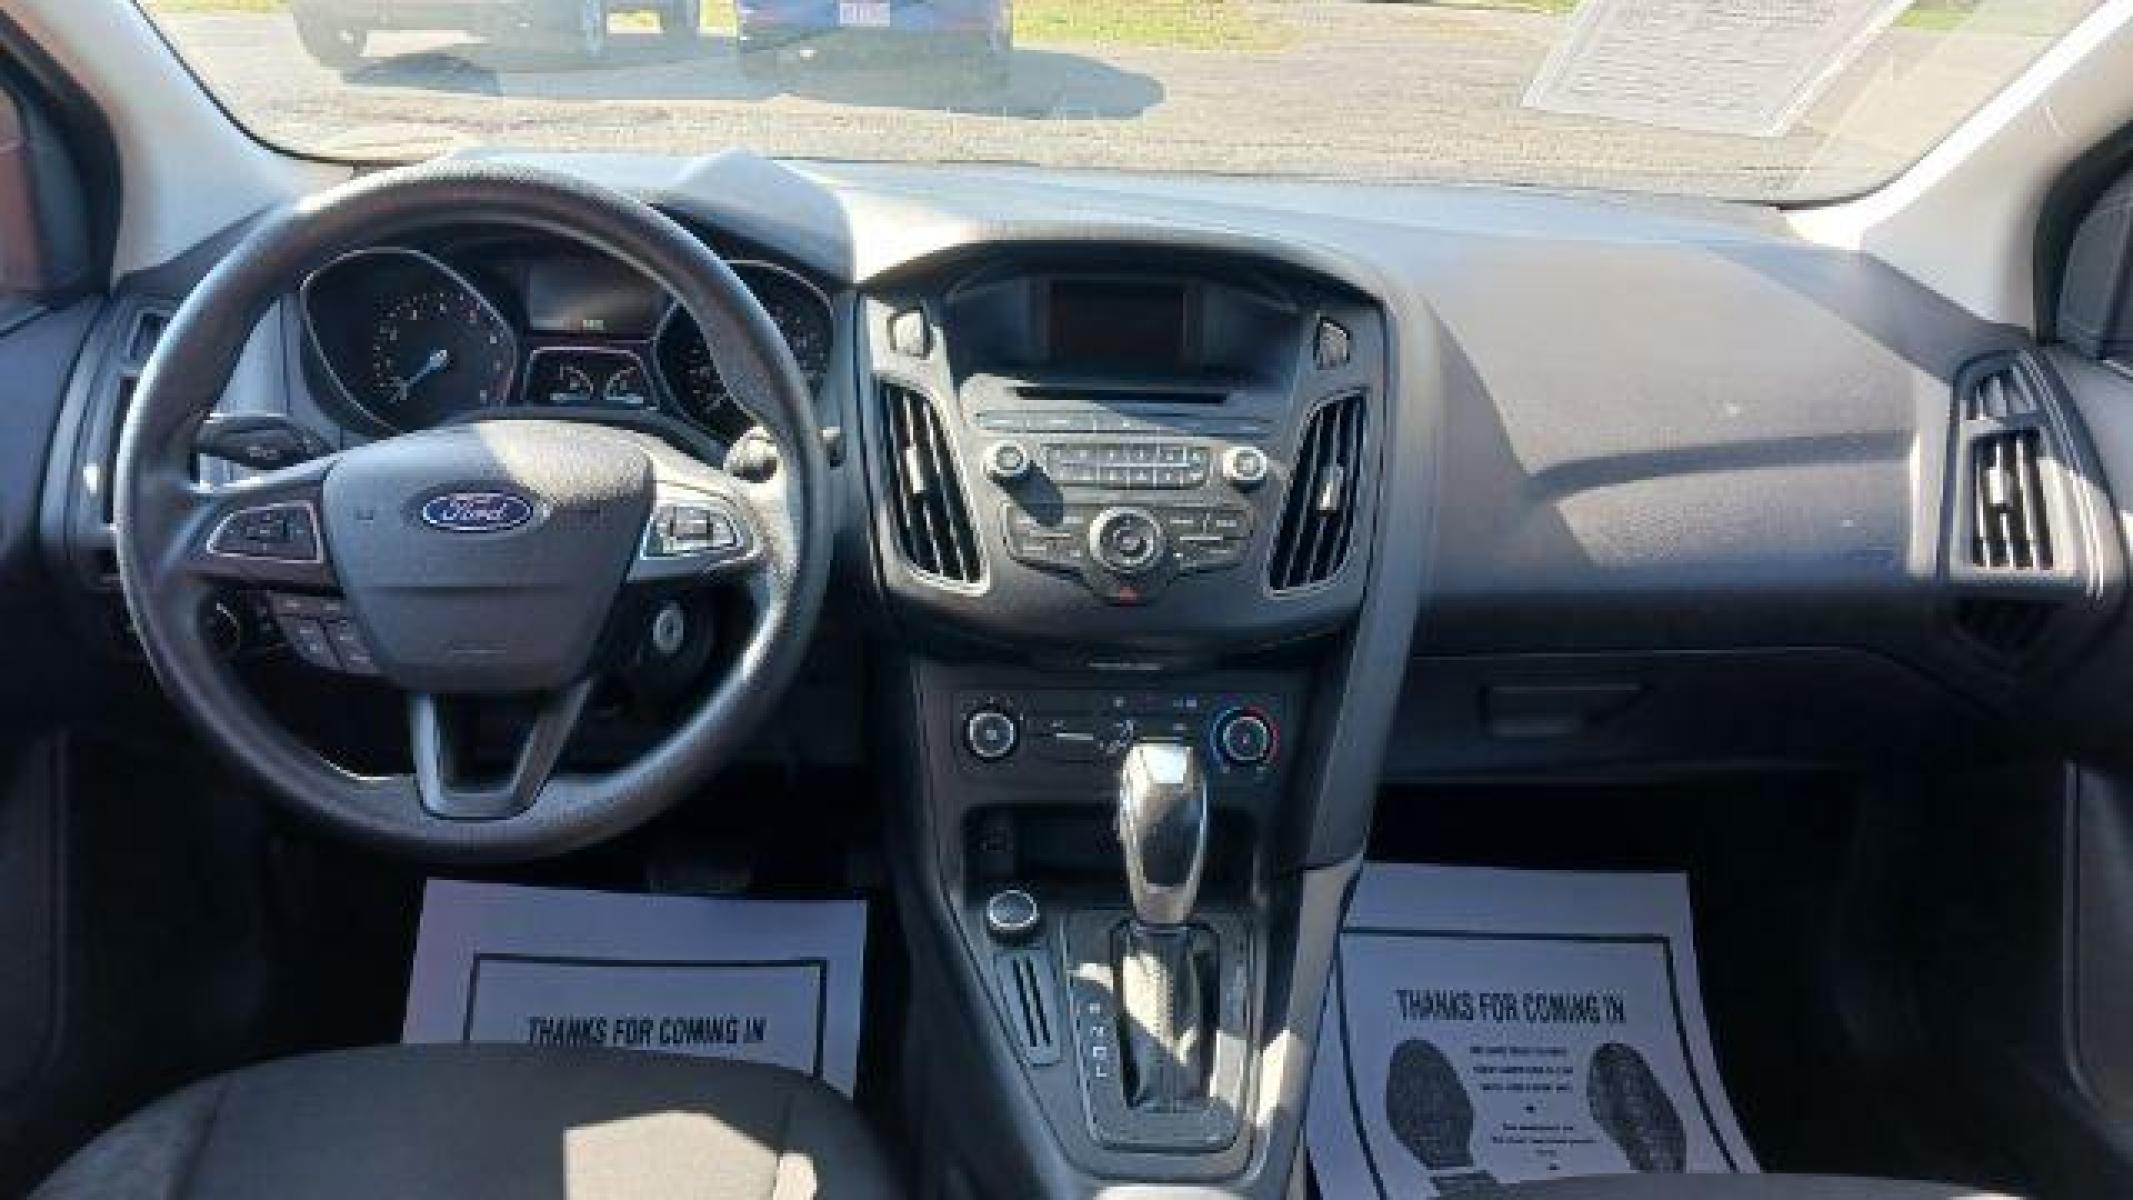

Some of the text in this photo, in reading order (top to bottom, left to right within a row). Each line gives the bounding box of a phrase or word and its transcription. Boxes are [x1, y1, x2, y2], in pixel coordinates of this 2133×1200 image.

[439, 493, 505, 520] Ford
[1396, 989, 1627, 1023] THANKS FOR COMING IN
[529, 1016, 767, 1045] THANKS FOR COMING IN
